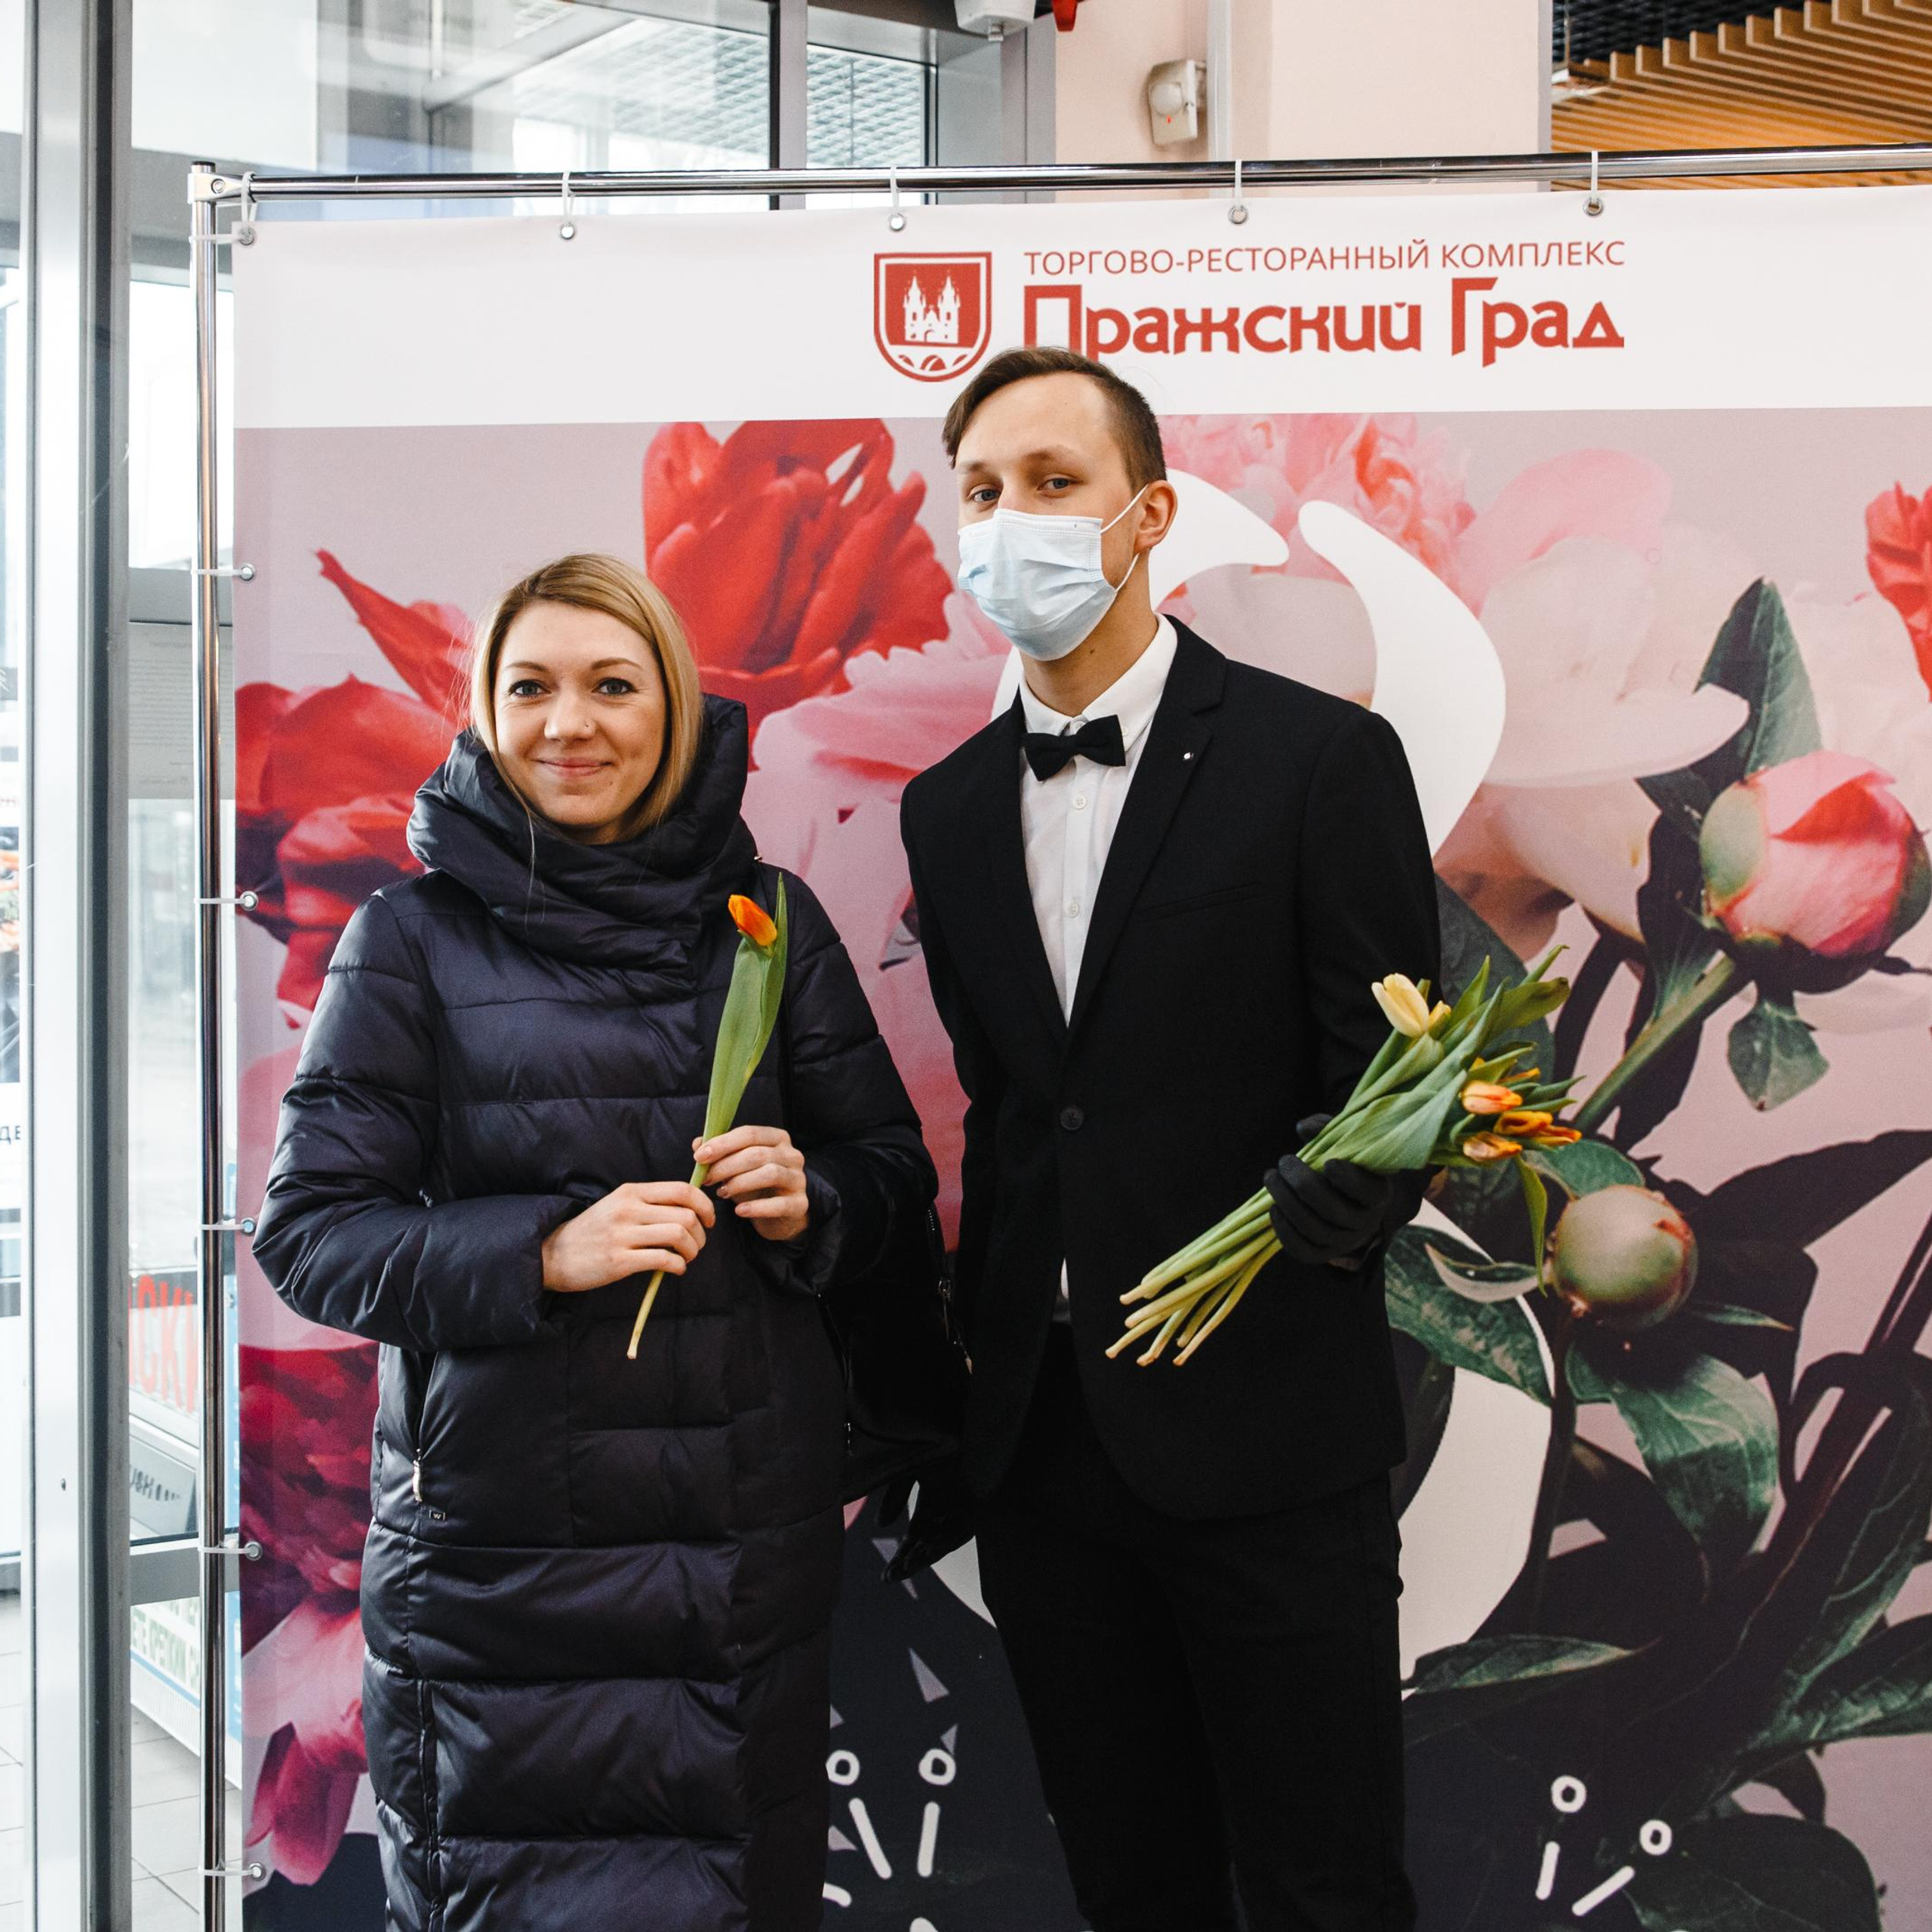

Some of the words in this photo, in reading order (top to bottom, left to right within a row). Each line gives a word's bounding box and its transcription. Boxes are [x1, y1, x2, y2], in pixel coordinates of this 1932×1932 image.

[1024, 238, 1429, 275] ТОРГОВО-РЕСТОРАННЫЙ
[1441, 240, 1626, 269] КОМПЛЕКС
[1024, 284, 1421, 364] Пражский
[1451, 276, 1625, 368] Град
